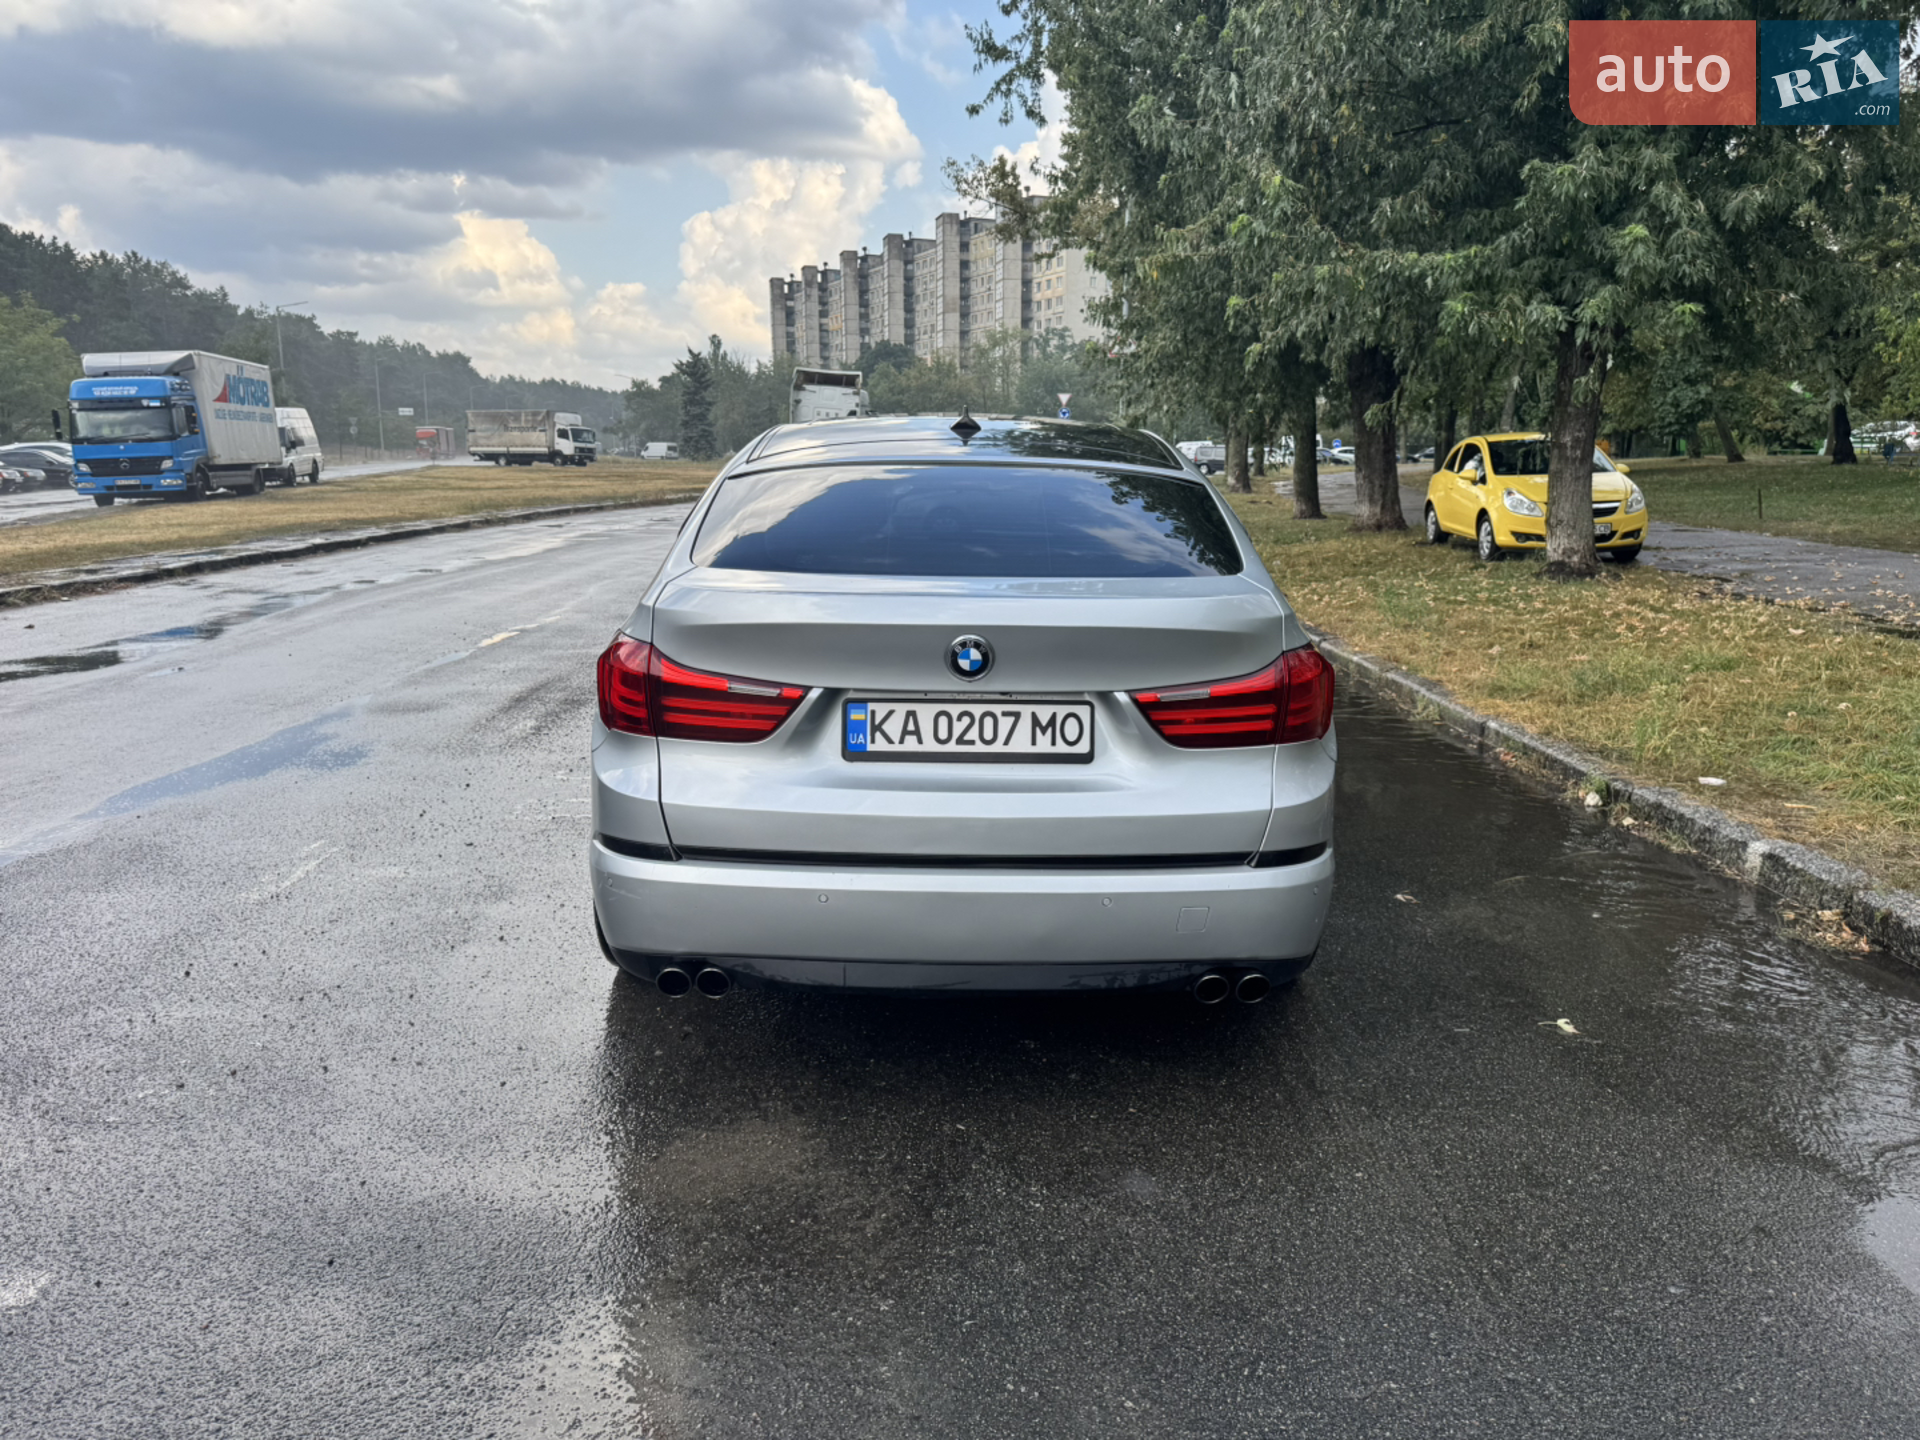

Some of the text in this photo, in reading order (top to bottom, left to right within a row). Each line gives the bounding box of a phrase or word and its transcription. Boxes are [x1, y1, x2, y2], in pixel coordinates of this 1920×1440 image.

[849, 733, 866, 745] UA
[869, 709, 1085, 748] KA 0207 MO
